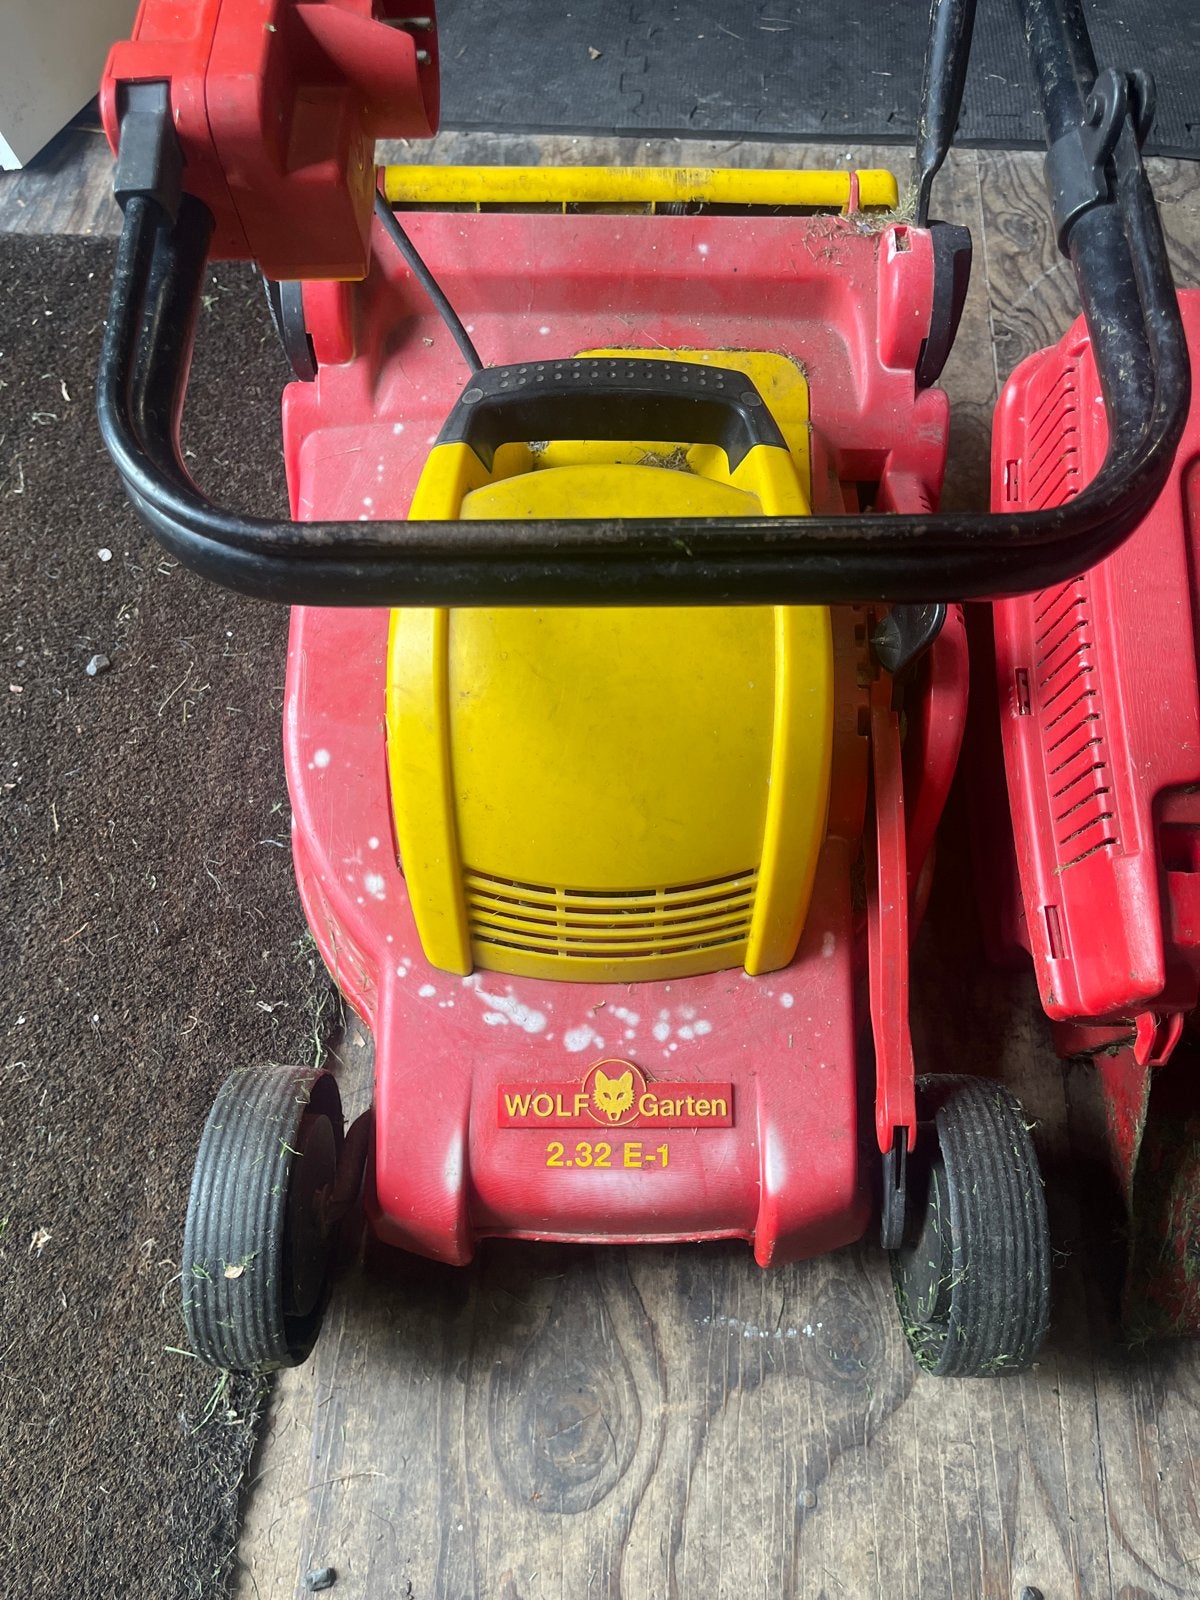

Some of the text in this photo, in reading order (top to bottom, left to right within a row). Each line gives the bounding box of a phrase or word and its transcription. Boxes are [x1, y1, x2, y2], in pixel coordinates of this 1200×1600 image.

[505, 1093, 728, 1117] WOLF Garten
[546, 1141, 669, 1169] 2.32 E-1
